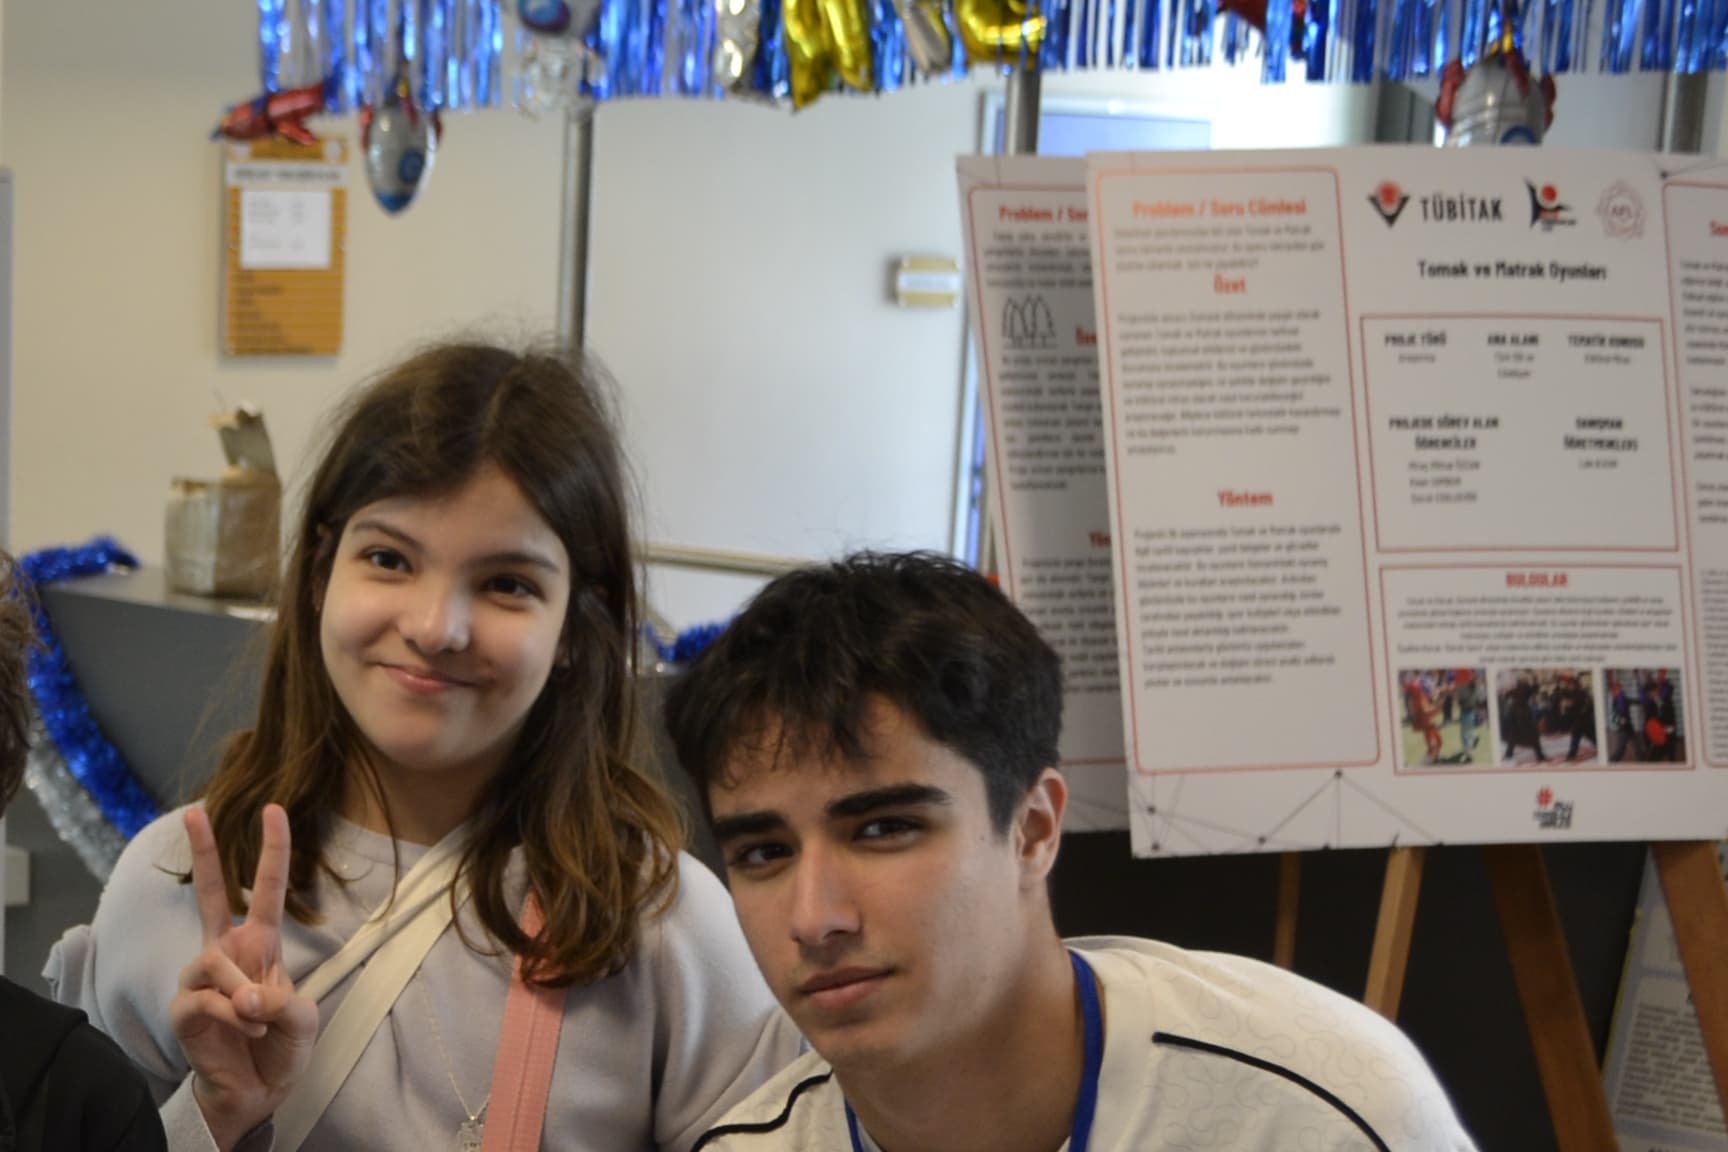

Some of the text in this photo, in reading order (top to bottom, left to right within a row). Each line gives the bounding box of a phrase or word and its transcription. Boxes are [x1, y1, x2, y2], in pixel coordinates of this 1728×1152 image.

[1420, 193, 1503, 222] TÜBİTAK
[1418, 261, 1607, 282] Tomak ve Matrak Oyunları
[1214, 274, 1246, 294] Özet
[1218, 491, 1274, 507] Yöntem
[1506, 573, 1568, 588] BULGULAR
